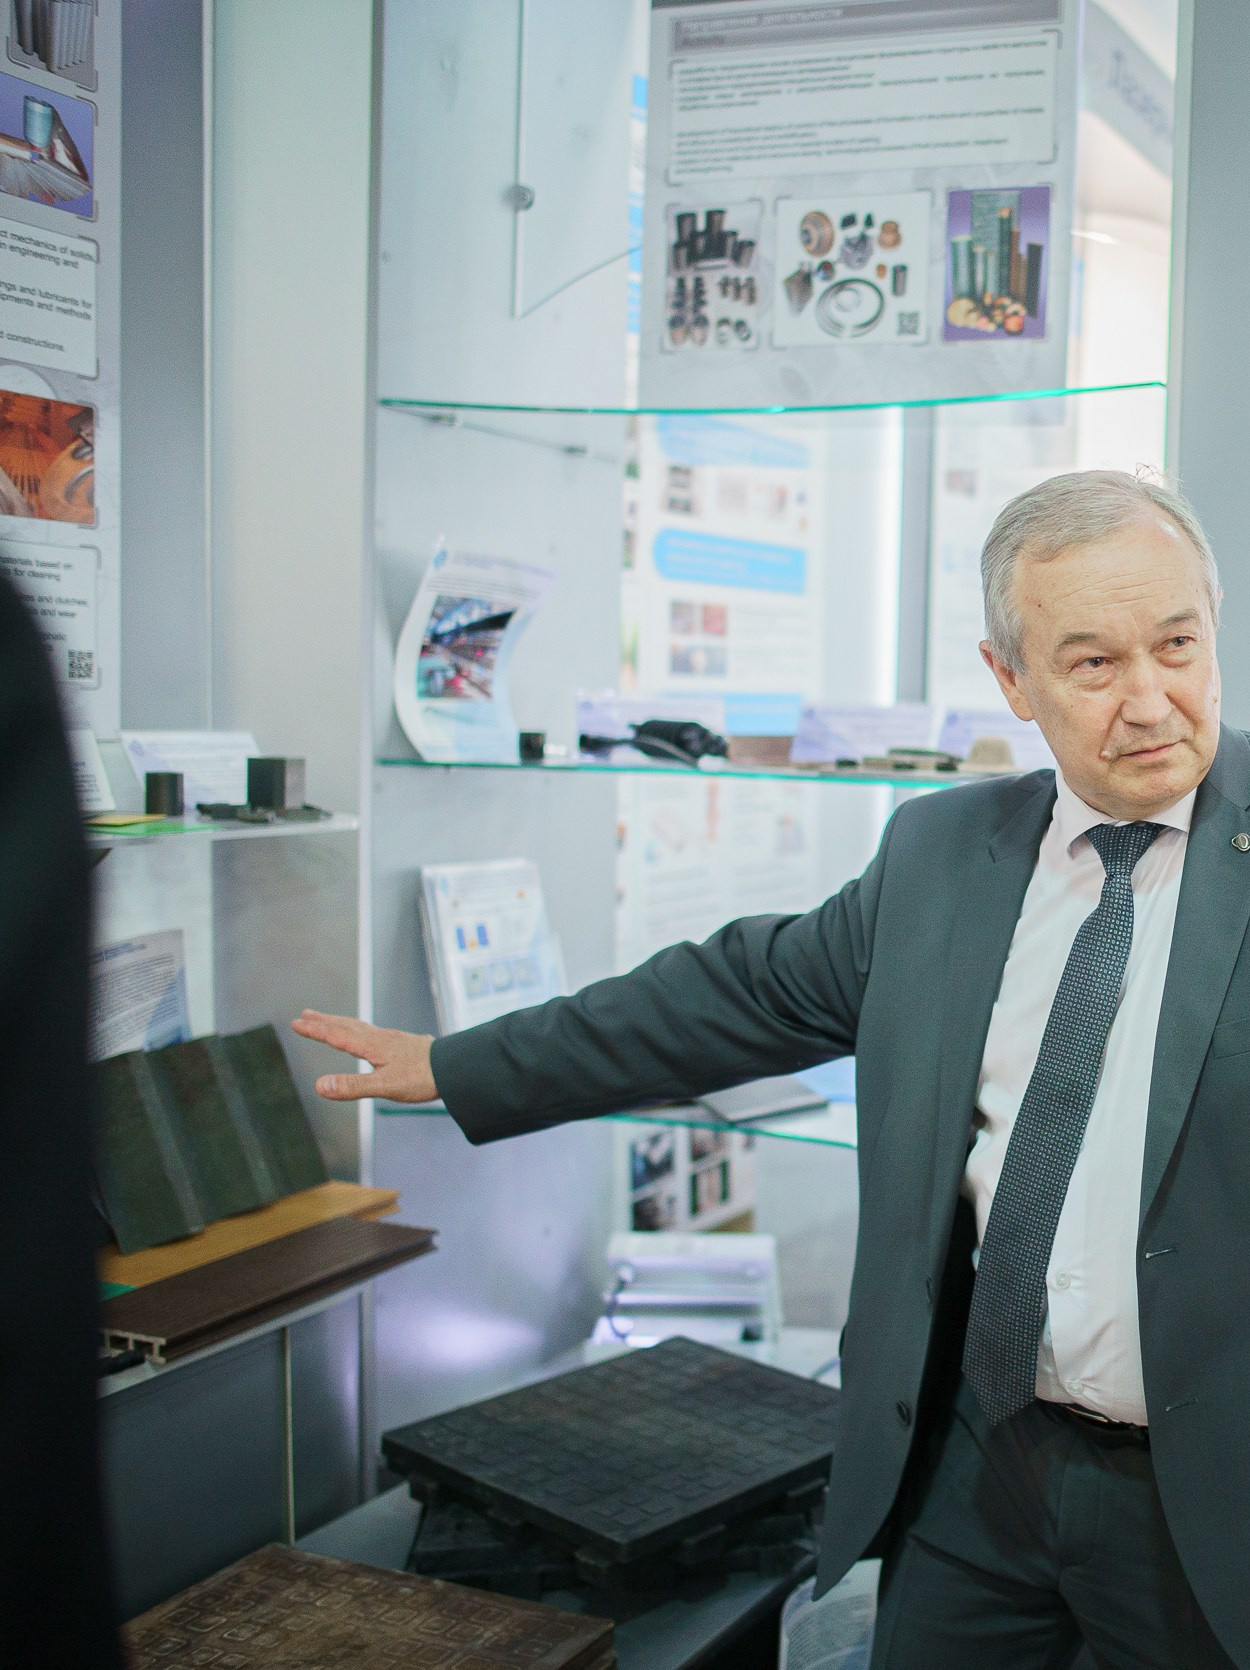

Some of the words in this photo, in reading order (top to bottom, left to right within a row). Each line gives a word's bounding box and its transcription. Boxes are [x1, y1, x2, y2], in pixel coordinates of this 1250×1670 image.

[10, 232, 57, 252] mechanics
[59, 246, 68, 254] of
[9, 245, 61, 266] engineering
[62, 259, 79, 270] and
[19, 285, 36, 295] and
[38, 288, 79, 306] lubricants
[37, 302, 54, 313] and
[56, 305, 92, 321] methods
